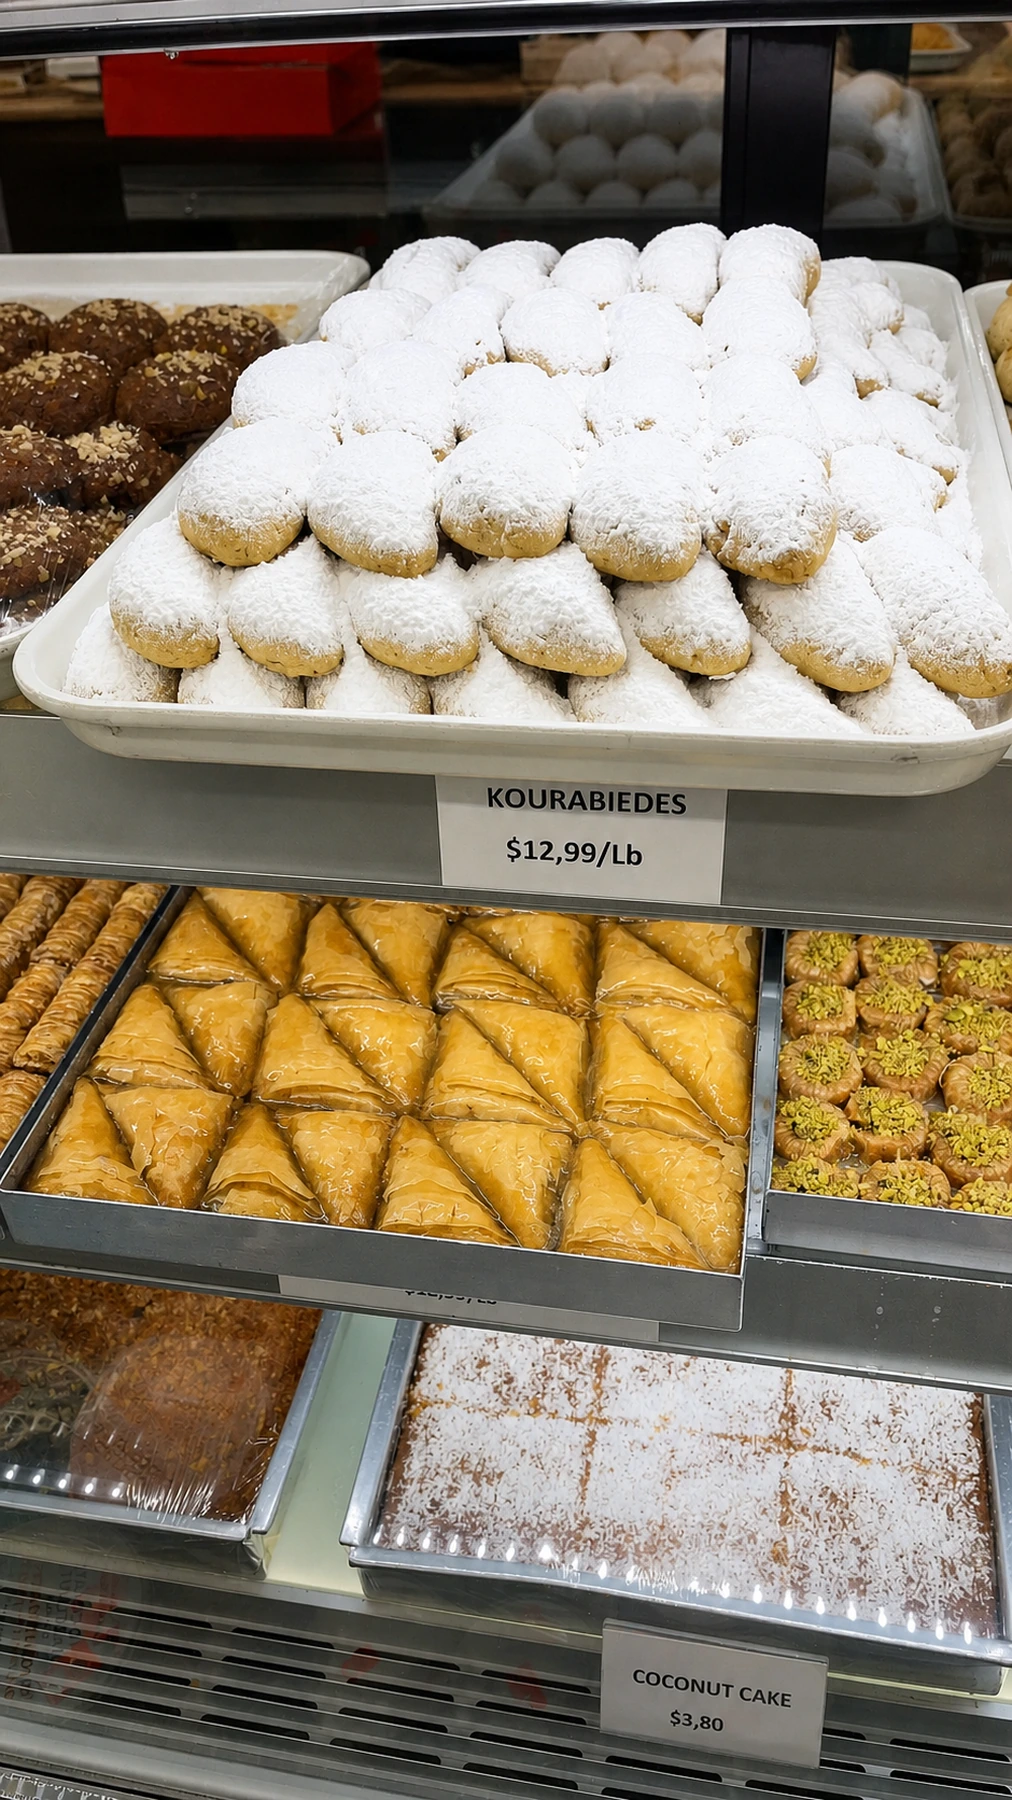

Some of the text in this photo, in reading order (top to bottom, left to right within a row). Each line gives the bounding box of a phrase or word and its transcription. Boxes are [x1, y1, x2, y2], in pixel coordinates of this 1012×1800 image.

[487, 787, 687, 815] KOURABIEDES
[506, 836, 643, 868] $12,99/Lb
[632, 1669, 792, 1708] COCONUT CAKE
[670, 1709, 724, 1732] $3,80
